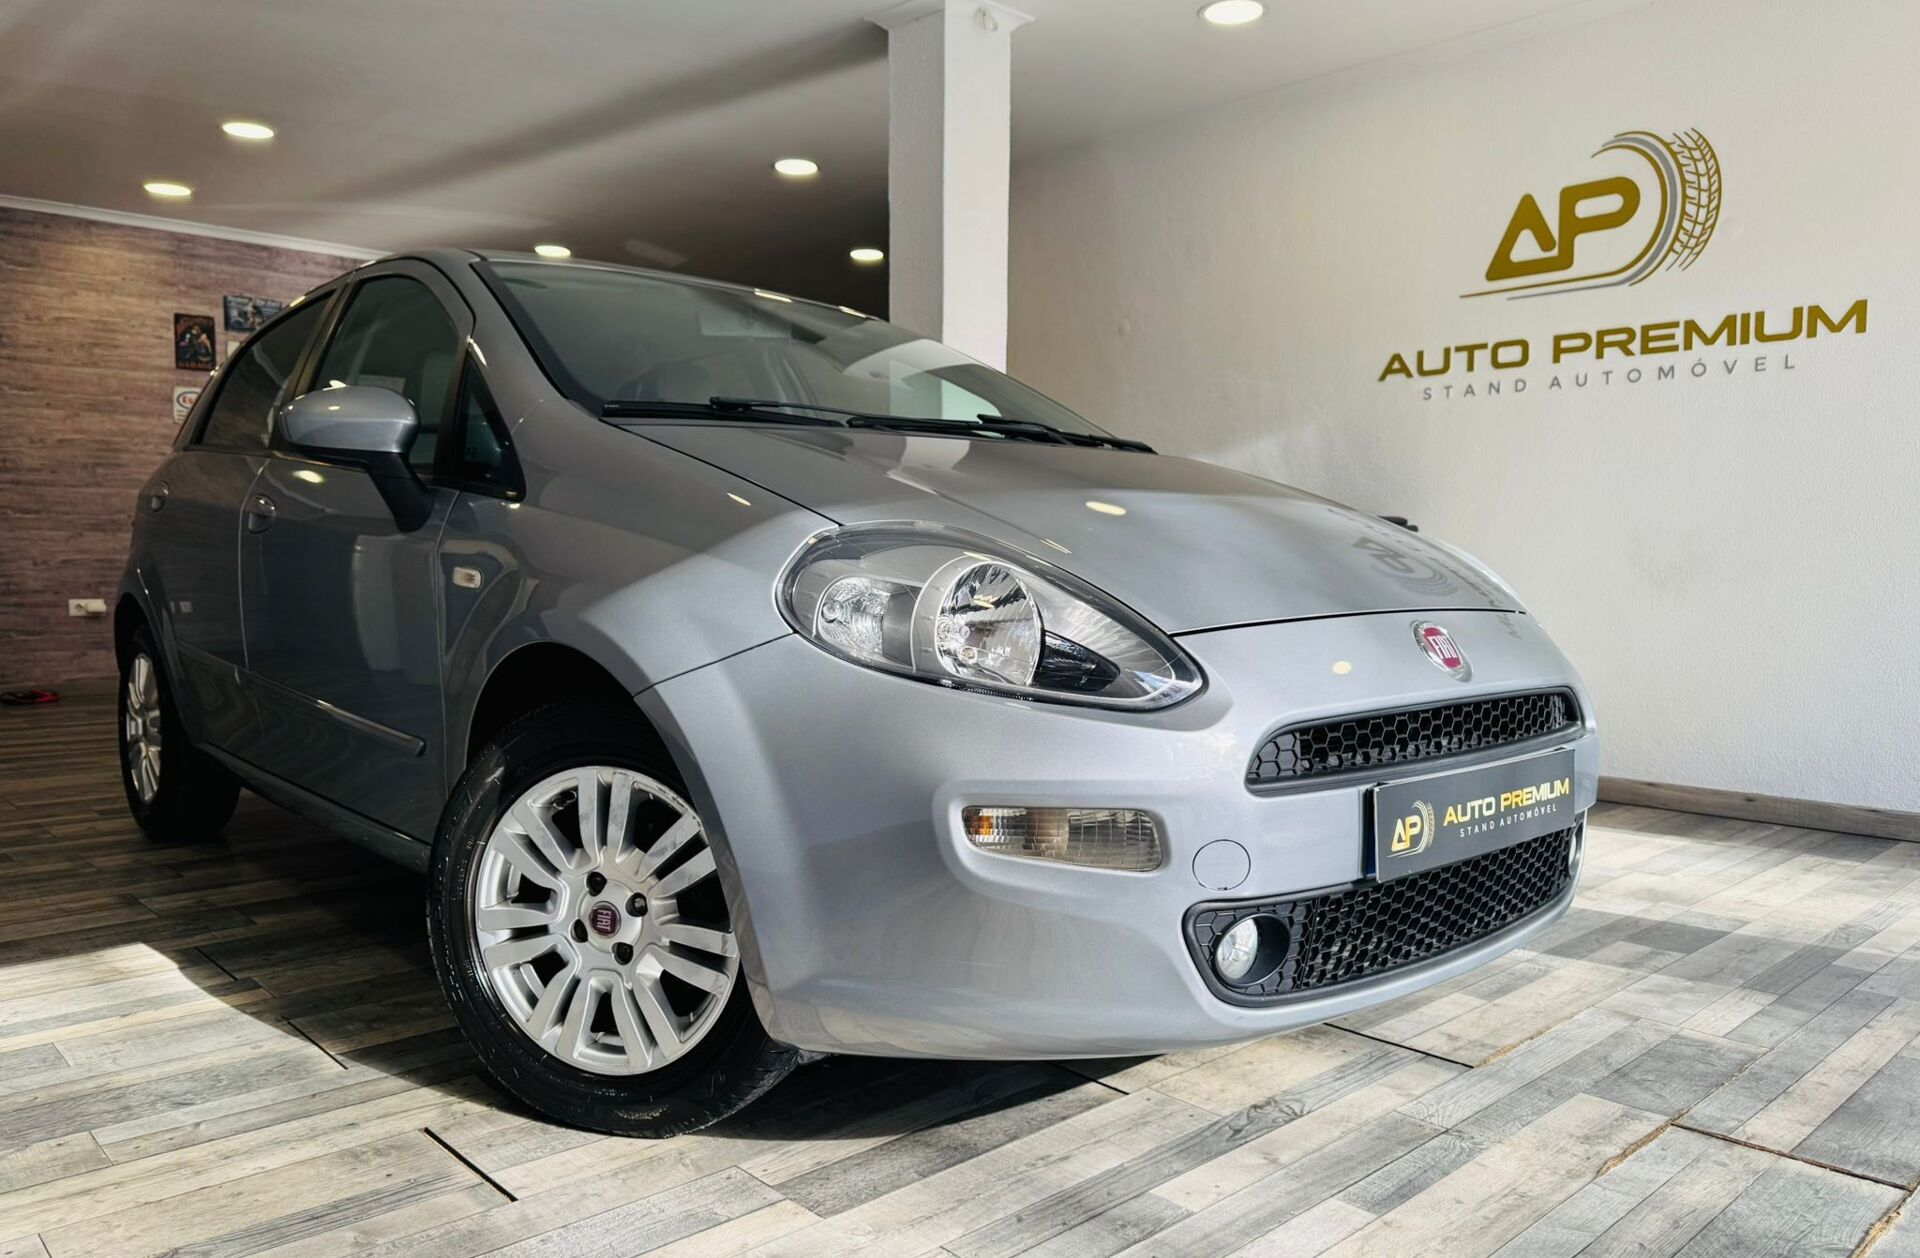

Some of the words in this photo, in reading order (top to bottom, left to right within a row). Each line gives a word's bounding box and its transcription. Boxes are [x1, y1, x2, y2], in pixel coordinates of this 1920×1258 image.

[1485, 176, 1641, 282] AP
[1378, 338, 1530, 383] AUTO
[1552, 299, 1868, 364] PREMIUM
[1423, 378, 1528, 401] STAND
[1549, 353, 1796, 390] AUTOMÓVEL
[1443, 796, 1496, 826] AUTO
[1500, 777, 1570, 812] PREMIUM
[1459, 821, 1496, 838] STAND
[1499, 804, 1558, 827] AUTOMÓVEL
[1391, 815, 1422, 852] AP
[596, 909, 612, 932] FIAT
